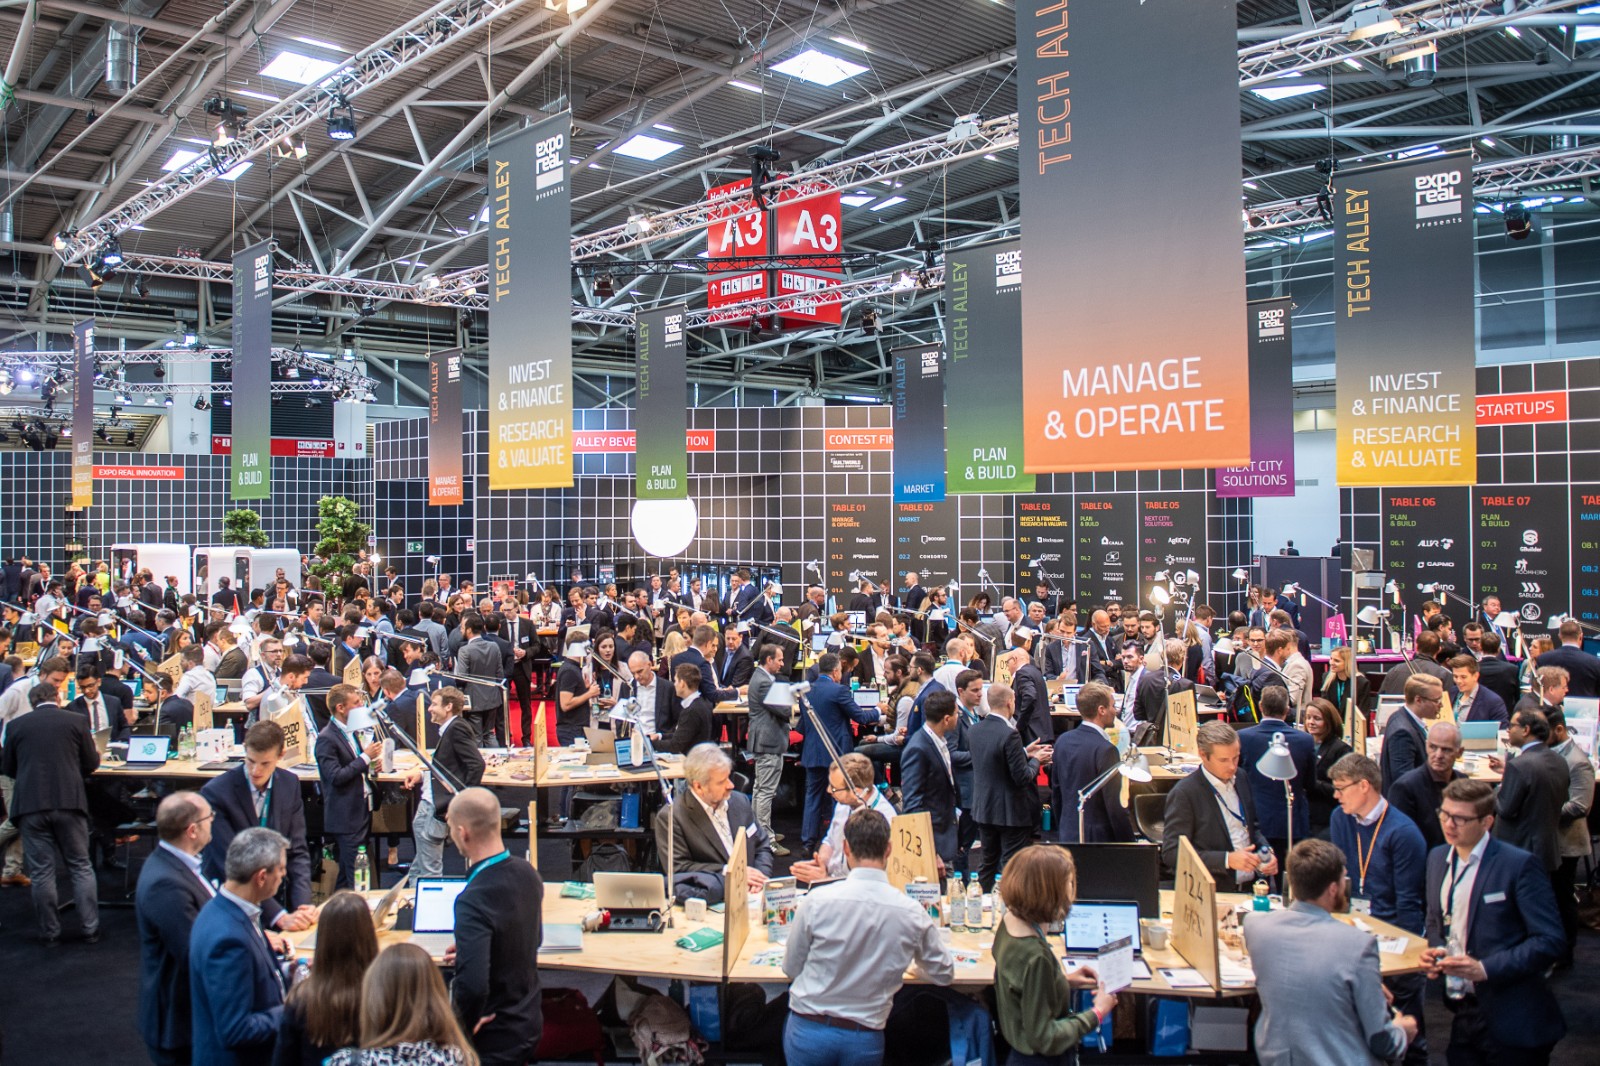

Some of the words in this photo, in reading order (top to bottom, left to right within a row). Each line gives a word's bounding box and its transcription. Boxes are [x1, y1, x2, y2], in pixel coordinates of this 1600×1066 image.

[1038, 71, 1072, 174] TECH
[496, 160, 510, 229] ALLEY
[536, 186, 564, 202] presents
[720, 207, 763, 252] A3
[1346, 188, 1369, 252] ALLEY
[1416, 216, 1462, 230] presents
[792, 210, 838, 252] A3
[496, 238, 510, 302] TECH
[953, 262, 968, 312] ALLEY
[1347, 260, 1370, 318] TECH
[640, 321, 649, 361] ALLEY
[953, 318, 968, 362] TECH
[509, 360, 552, 384] INVEST
[640, 365, 649, 400] TECH
[896, 357, 905, 389] ALLEY
[1062, 356, 1201, 398] MANAGE
[1370, 371, 1442, 392] INVEST
[498, 392, 508, 411] &
[510, 384, 564, 410] FINANCE
[897, 393, 906, 420] TECH
[1352, 399, 1367, 416] &
[1372, 394, 1460, 414] FINANCE
[1044, 410, 1066, 440] &
[1074, 399, 1224, 438] OPERATE
[1476, 401, 1555, 418] STARTUPS
[500, 419, 564, 443] RESEARCH
[829, 435, 877, 444] CONTEST
[1353, 425, 1460, 445] RESEARCH
[576, 437, 606, 447] ALLEY
[610, 437, 636, 447] BEVE
[242, 453, 258, 467] PLAN
[498, 452, 508, 468] &
[510, 445, 564, 467] VALUATE
[973, 447, 1006, 462] PLAN
[1352, 451, 1367, 468] &
[1372, 448, 1461, 467] VALUATE
[651, 465, 671, 476] PLAN
[965, 467, 975, 480] &
[978, 465, 1016, 479] BUILD
[1258, 460, 1283, 471] CITY
[238, 472, 245, 486] &
[246, 471, 262, 485] BUILD
[435, 476, 457, 485] MANAGE
[646, 480, 652, 490] &
[654, 479, 676, 489] BUILD
[904, 484, 934, 494] MARKET
[1223, 475, 1287, 486] SOLUTIONS
[438, 486, 460, 496] OPERATE
[1481, 496, 1514, 506] TABLE
[1516, 496, 1531, 506] 07
[1390, 497, 1420, 506] TABLE
[1422, 497, 1436, 507] 06
[1172, 702, 1187, 716] 10.1
[899, 828, 922, 857] 12.3
